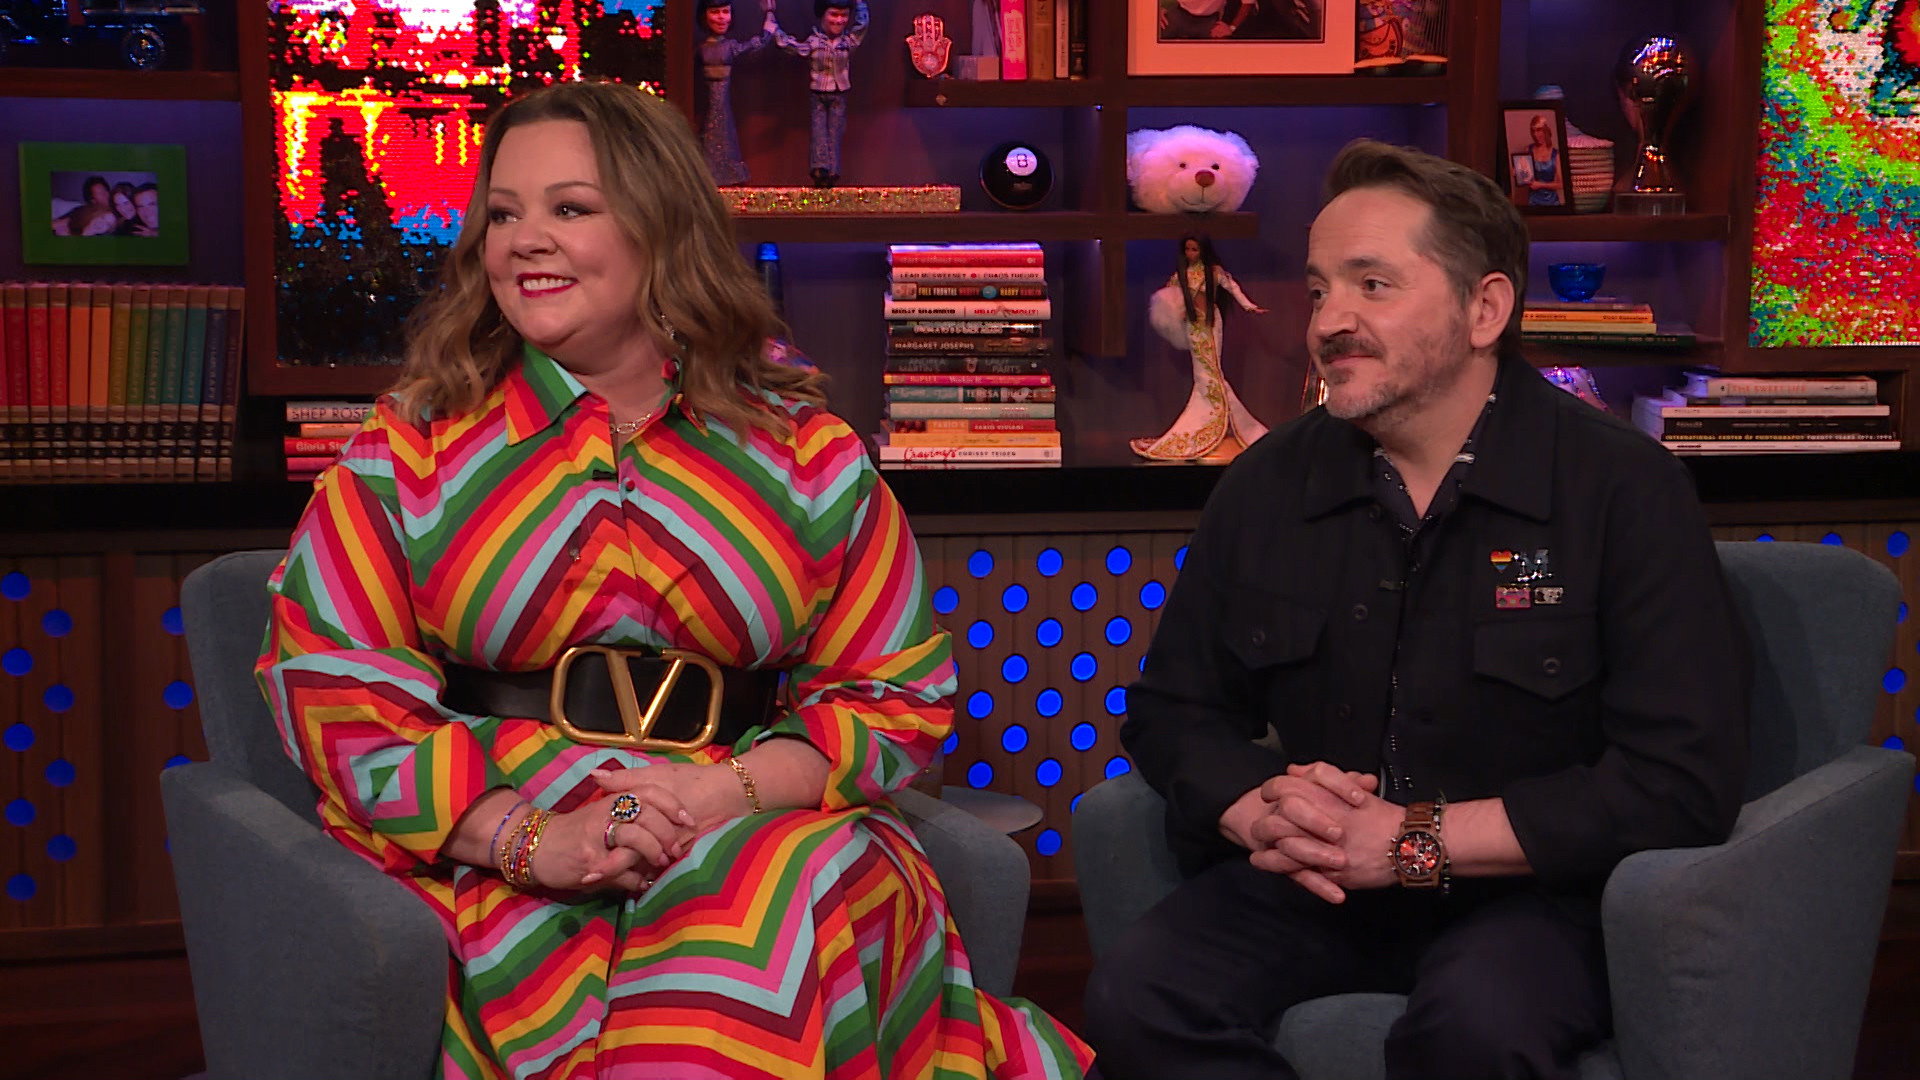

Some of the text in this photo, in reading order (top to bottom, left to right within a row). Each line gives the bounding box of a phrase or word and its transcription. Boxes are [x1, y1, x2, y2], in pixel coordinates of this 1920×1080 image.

[1016, 153, 1028, 168] 8
[291, 407, 327, 420] SHEP
[295, 441, 326, 452] Gloria
[904, 447, 957, 461] Cravings
